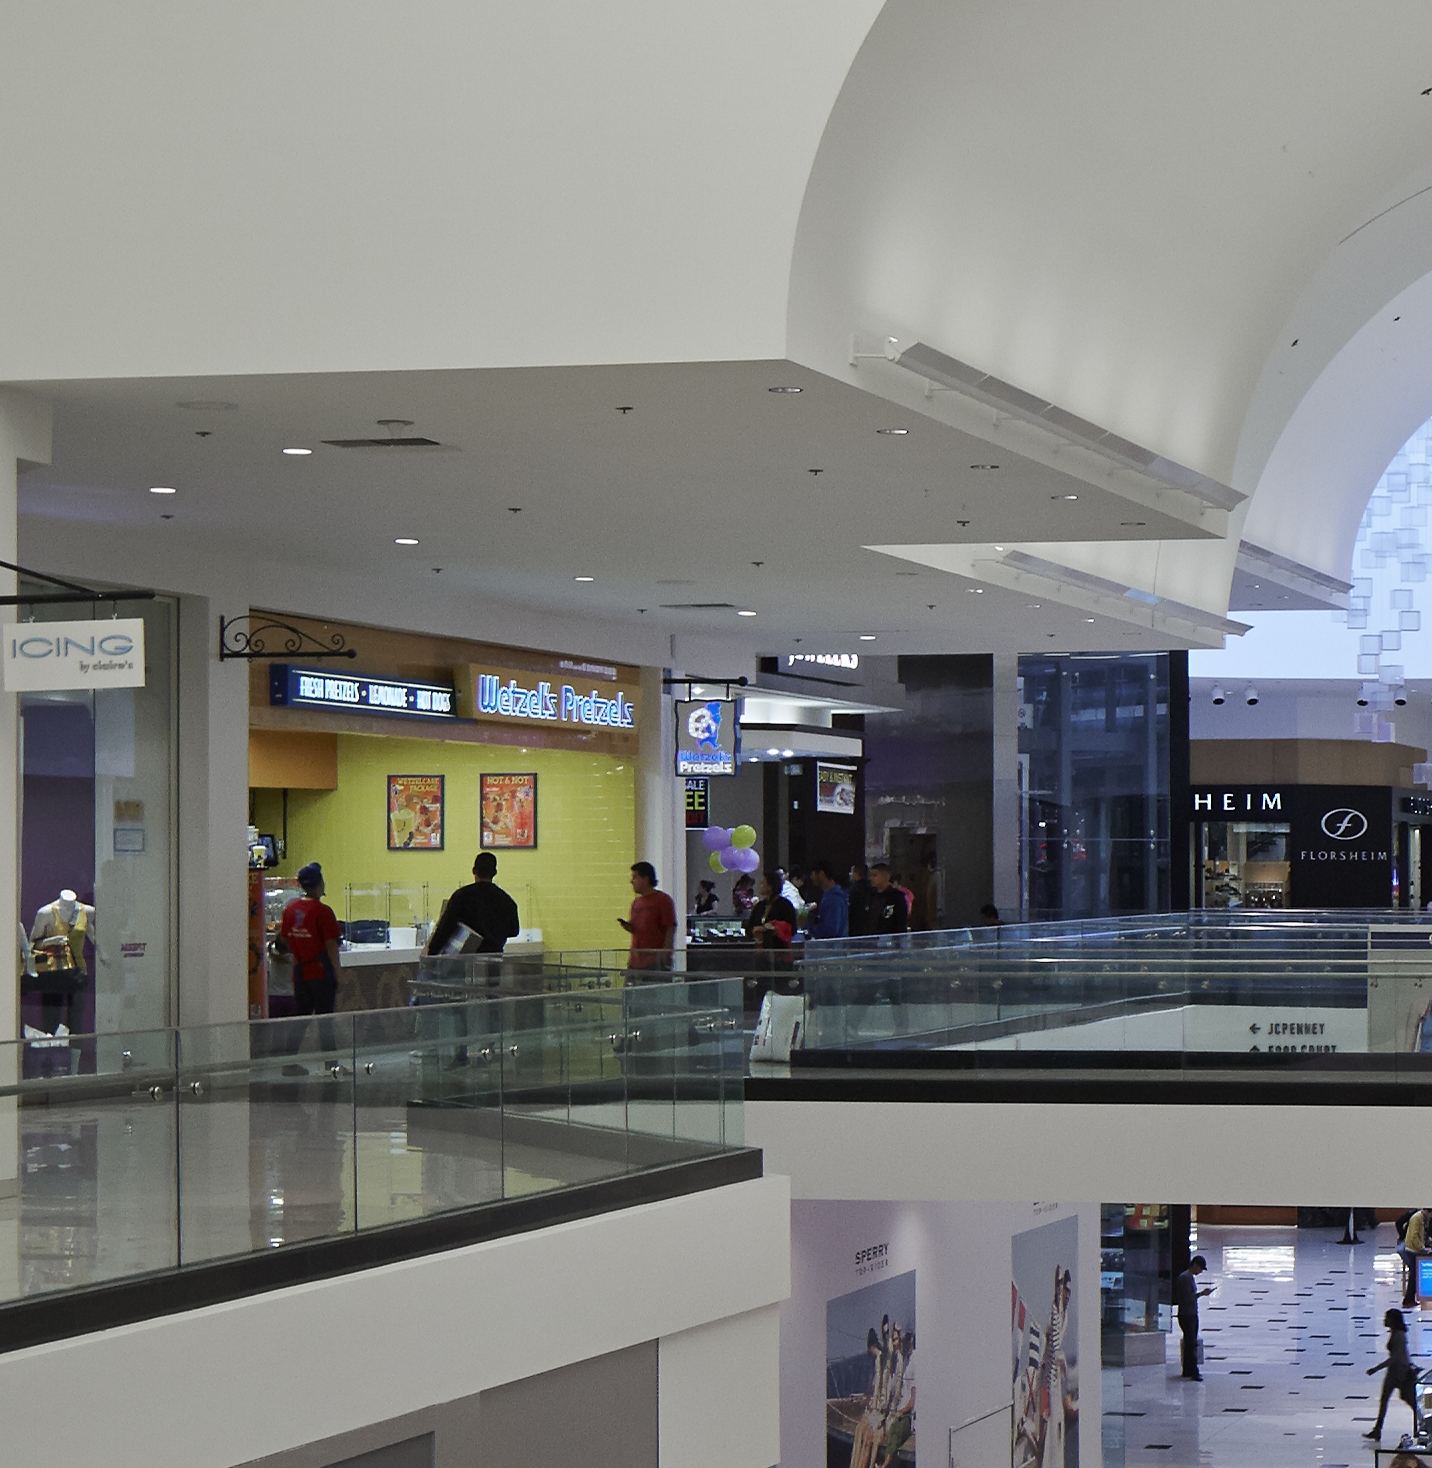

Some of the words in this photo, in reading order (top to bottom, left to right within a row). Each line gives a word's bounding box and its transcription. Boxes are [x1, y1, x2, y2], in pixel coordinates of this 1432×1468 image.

[11, 634, 134, 659] ICING
[79, 660, 90, 673] by
[92, 661, 134, 670] claire's
[477, 673, 558, 720] Wetzel's
[560, 684, 636, 729] Pretzels
[679, 762, 733, 774] Pretzels
[686, 780, 706, 791] ALE
[1300, 850, 1388, 862] FLORSHEIM
[1268, 1022, 1325, 1035] JCPENNEY
[854, 1242, 890, 1265] SPERRY
